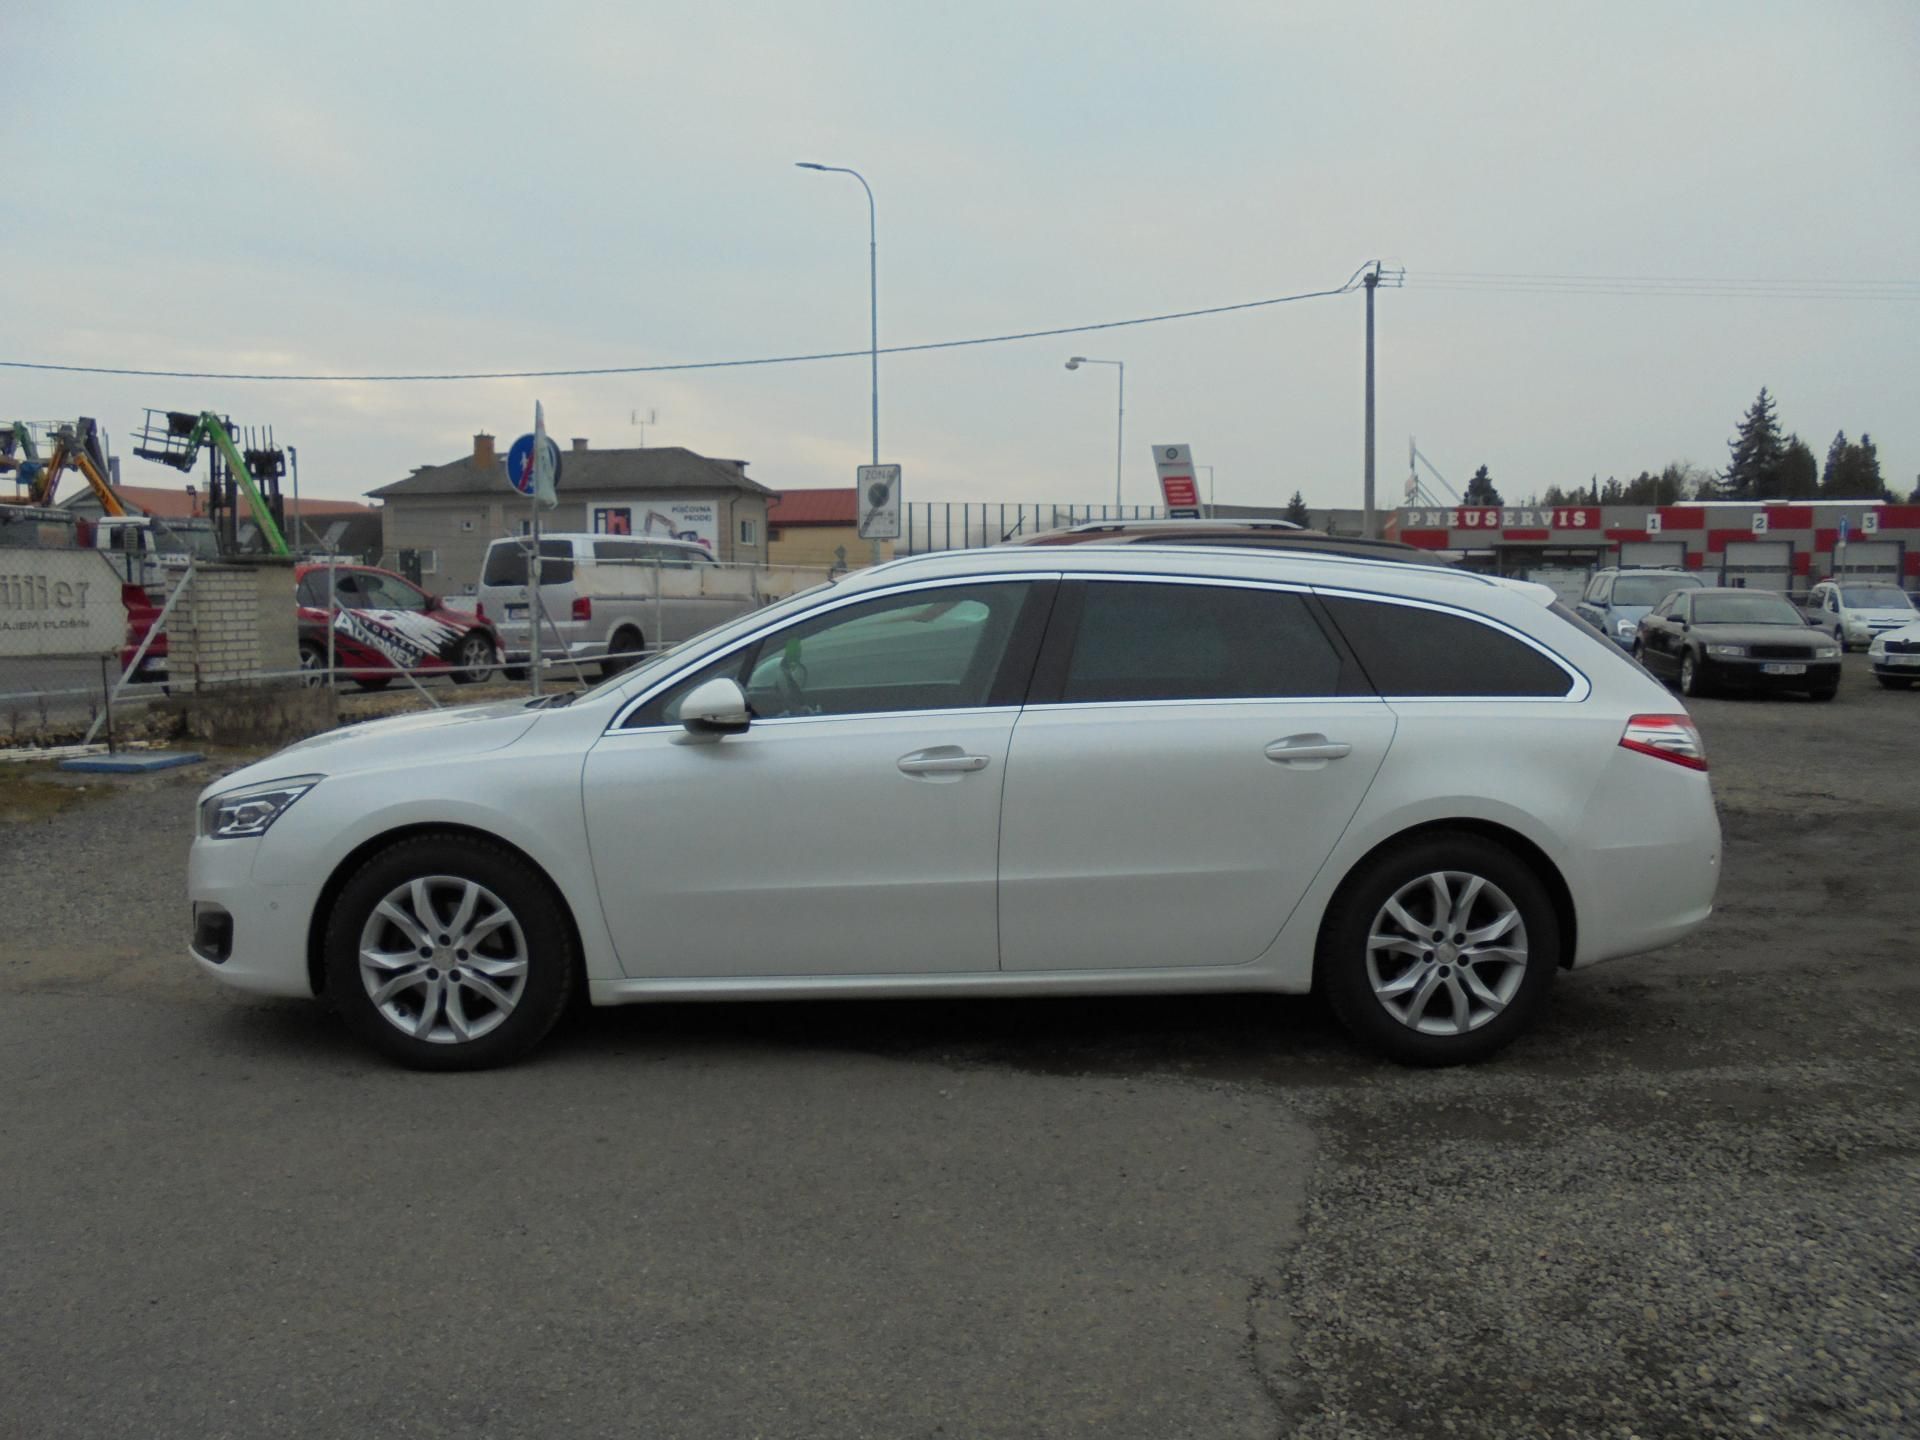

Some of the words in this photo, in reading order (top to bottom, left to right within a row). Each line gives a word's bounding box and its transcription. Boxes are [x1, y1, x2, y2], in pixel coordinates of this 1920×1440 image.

[1407, 511, 1587, 527] PNEUSERVIS
[1650, 517, 1657, 530] 1
[1755, 517, 1765, 529] 2
[1865, 516, 1875, 529] 3
